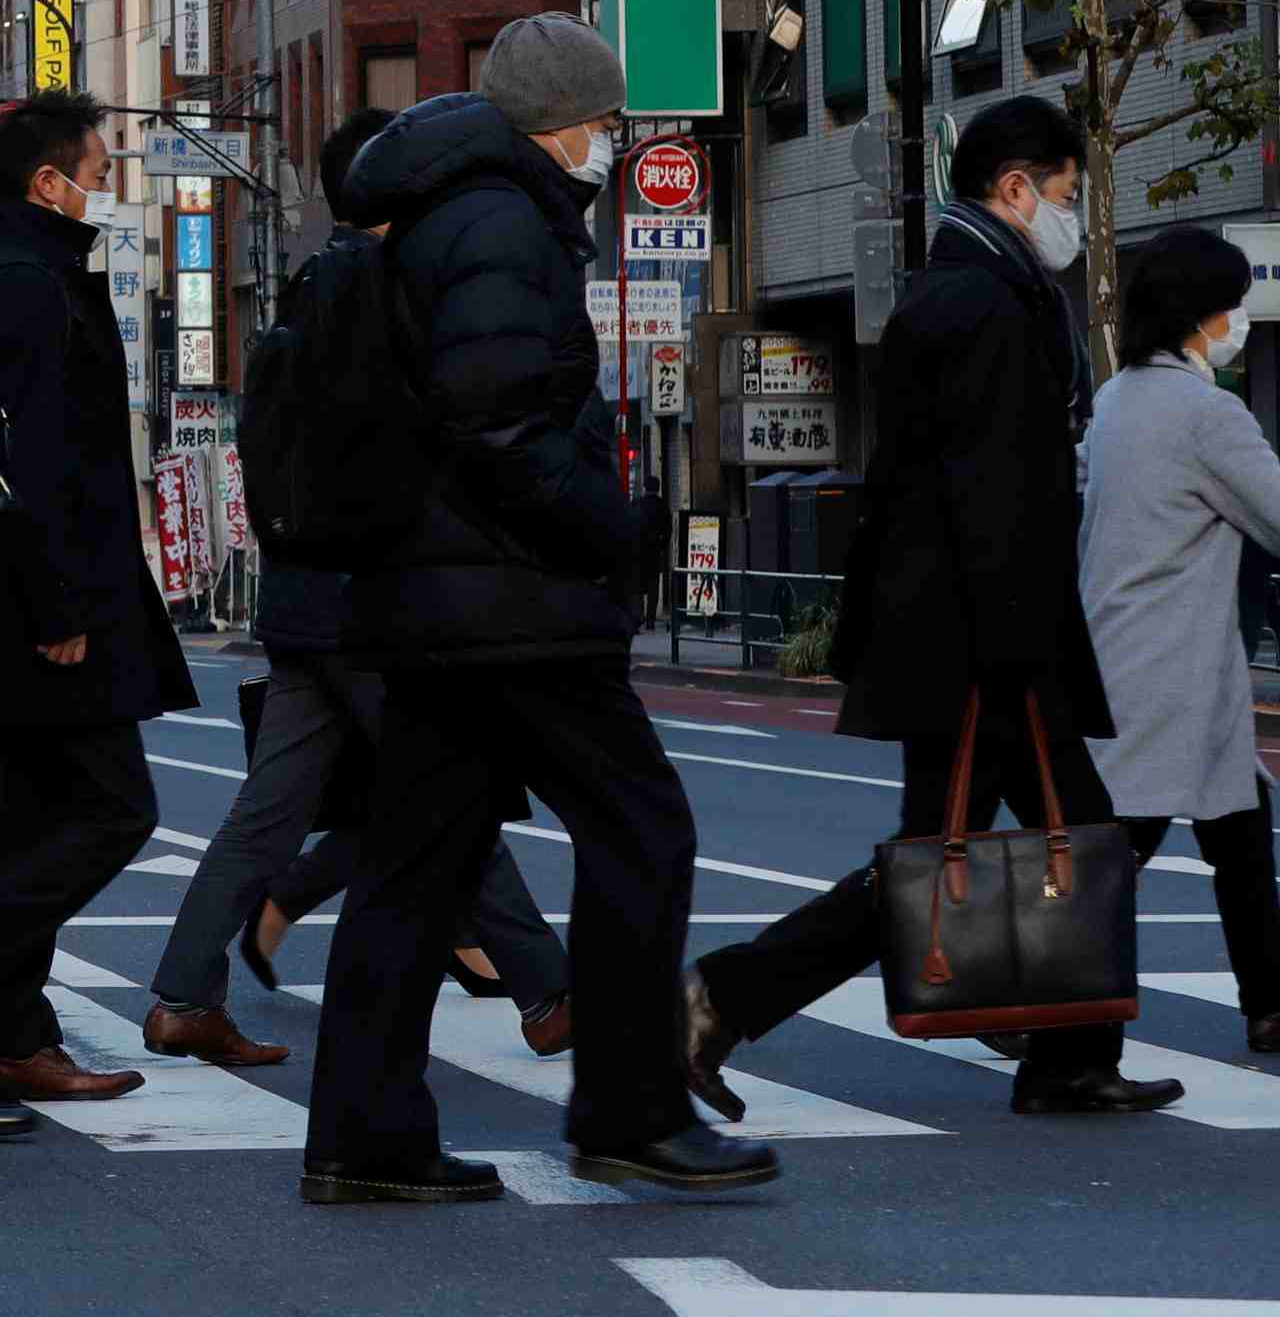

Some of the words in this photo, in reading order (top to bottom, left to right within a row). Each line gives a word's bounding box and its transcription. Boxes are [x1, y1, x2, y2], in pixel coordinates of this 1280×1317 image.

[642, 164, 693, 189] 消火栓
[637, 229, 699, 248] KEN
[175, 399, 217, 420] 炭火
[175, 426, 217, 448] 焼肉
[156, 469, 189, 568] 営業中
